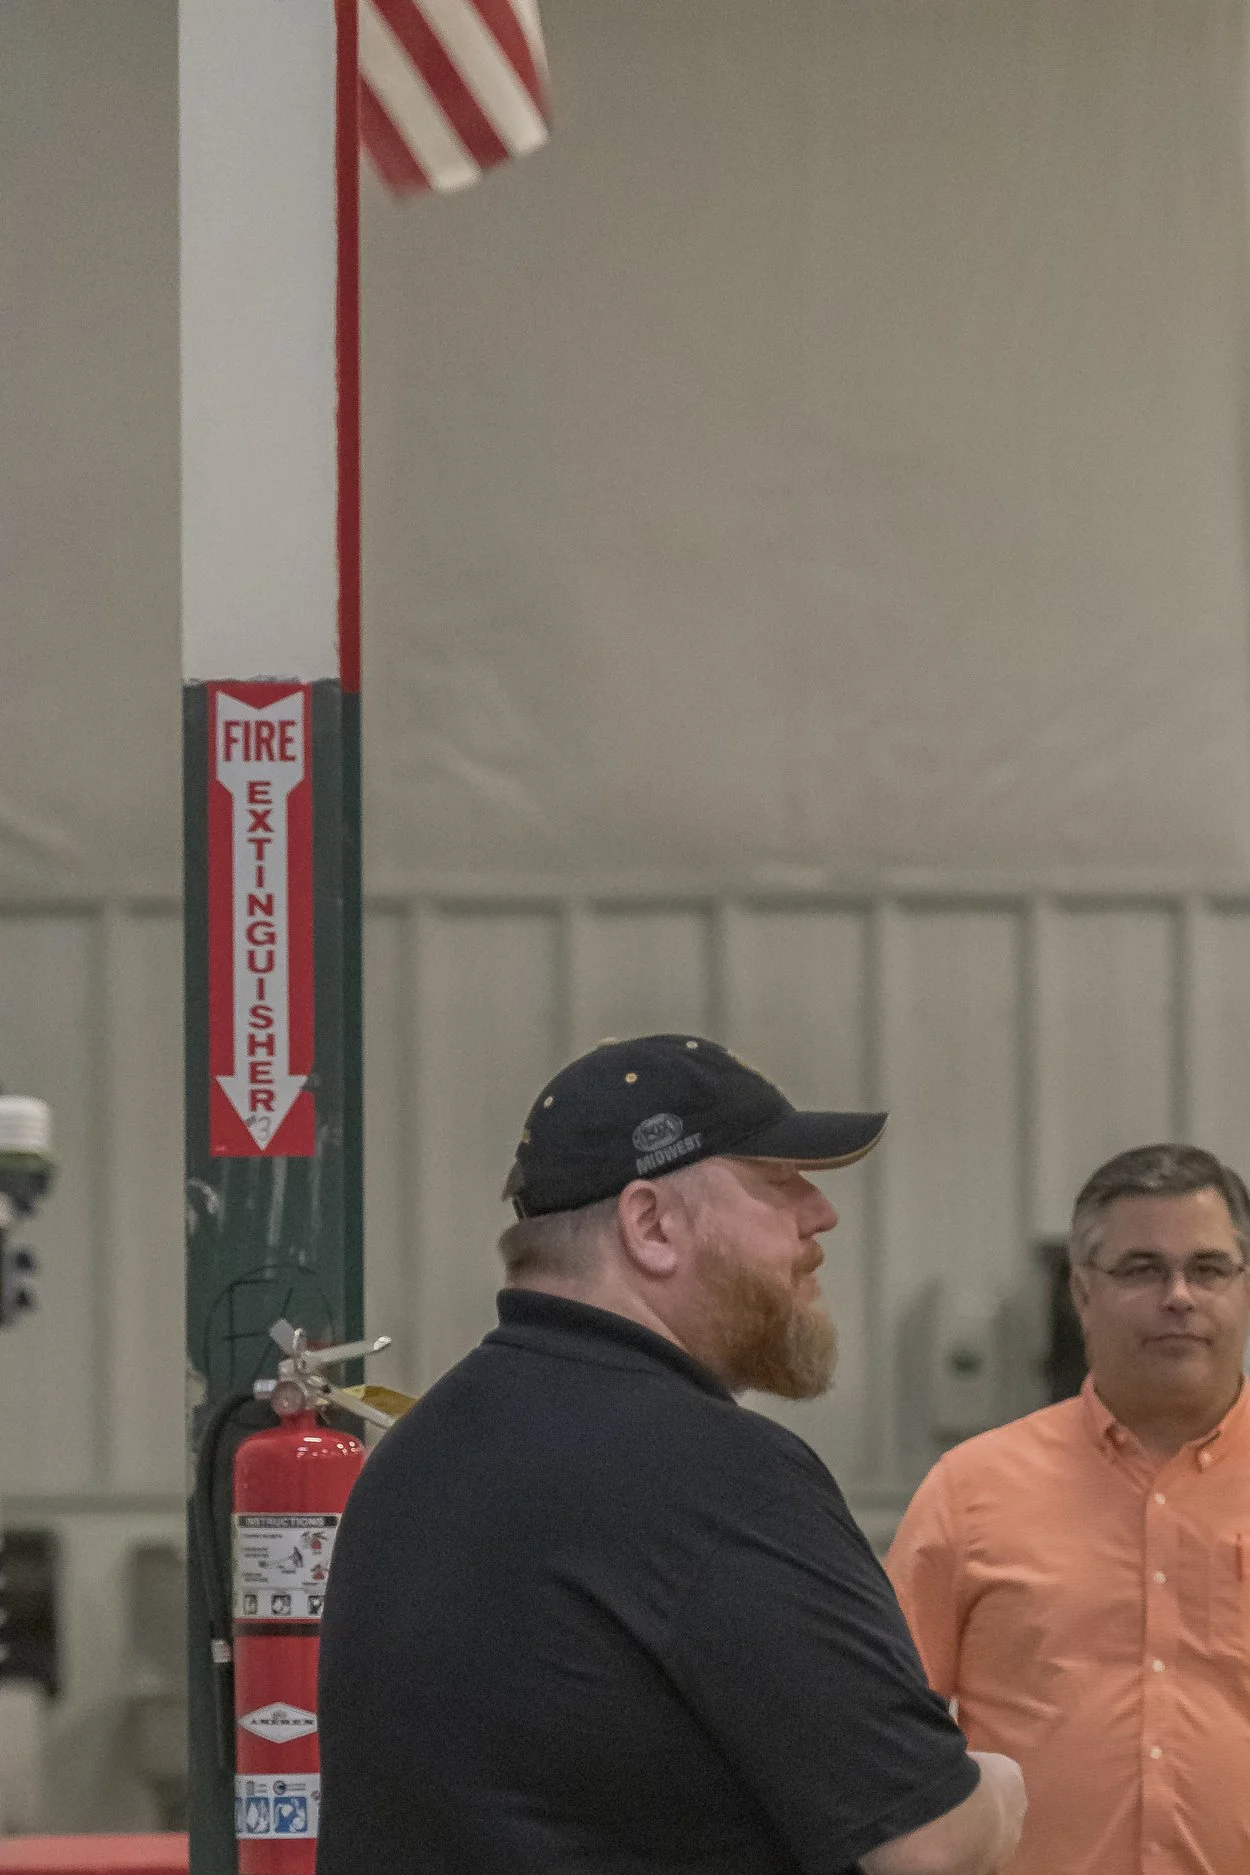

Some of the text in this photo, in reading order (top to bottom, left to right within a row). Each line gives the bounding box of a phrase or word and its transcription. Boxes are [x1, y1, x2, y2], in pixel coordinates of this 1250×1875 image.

[223, 719, 296, 762] FIRE
[246, 780, 277, 1112] EXTINGUISHER
[636, 1132, 702, 1175] MIDWEST
